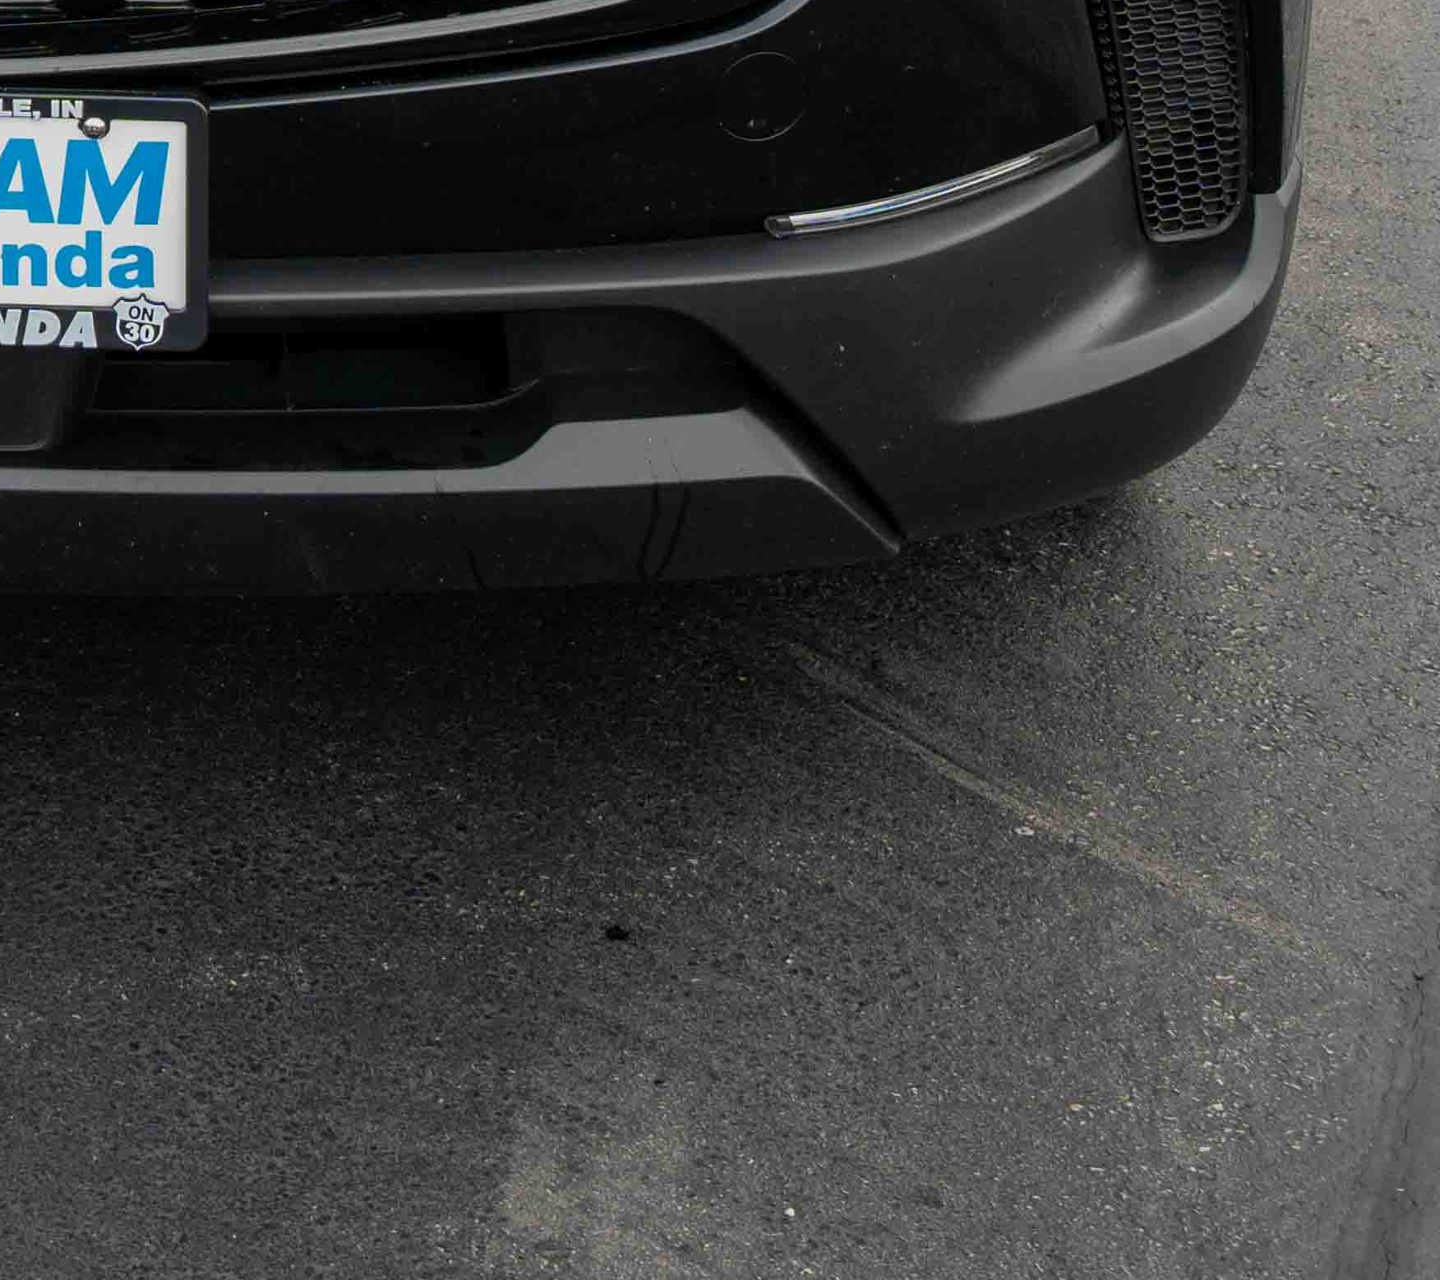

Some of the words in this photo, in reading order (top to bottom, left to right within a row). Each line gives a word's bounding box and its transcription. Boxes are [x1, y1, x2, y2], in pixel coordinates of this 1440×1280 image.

[50, 99, 84, 118] IN
[128, 305, 155, 322] ON
[123, 322, 156, 342] 30
